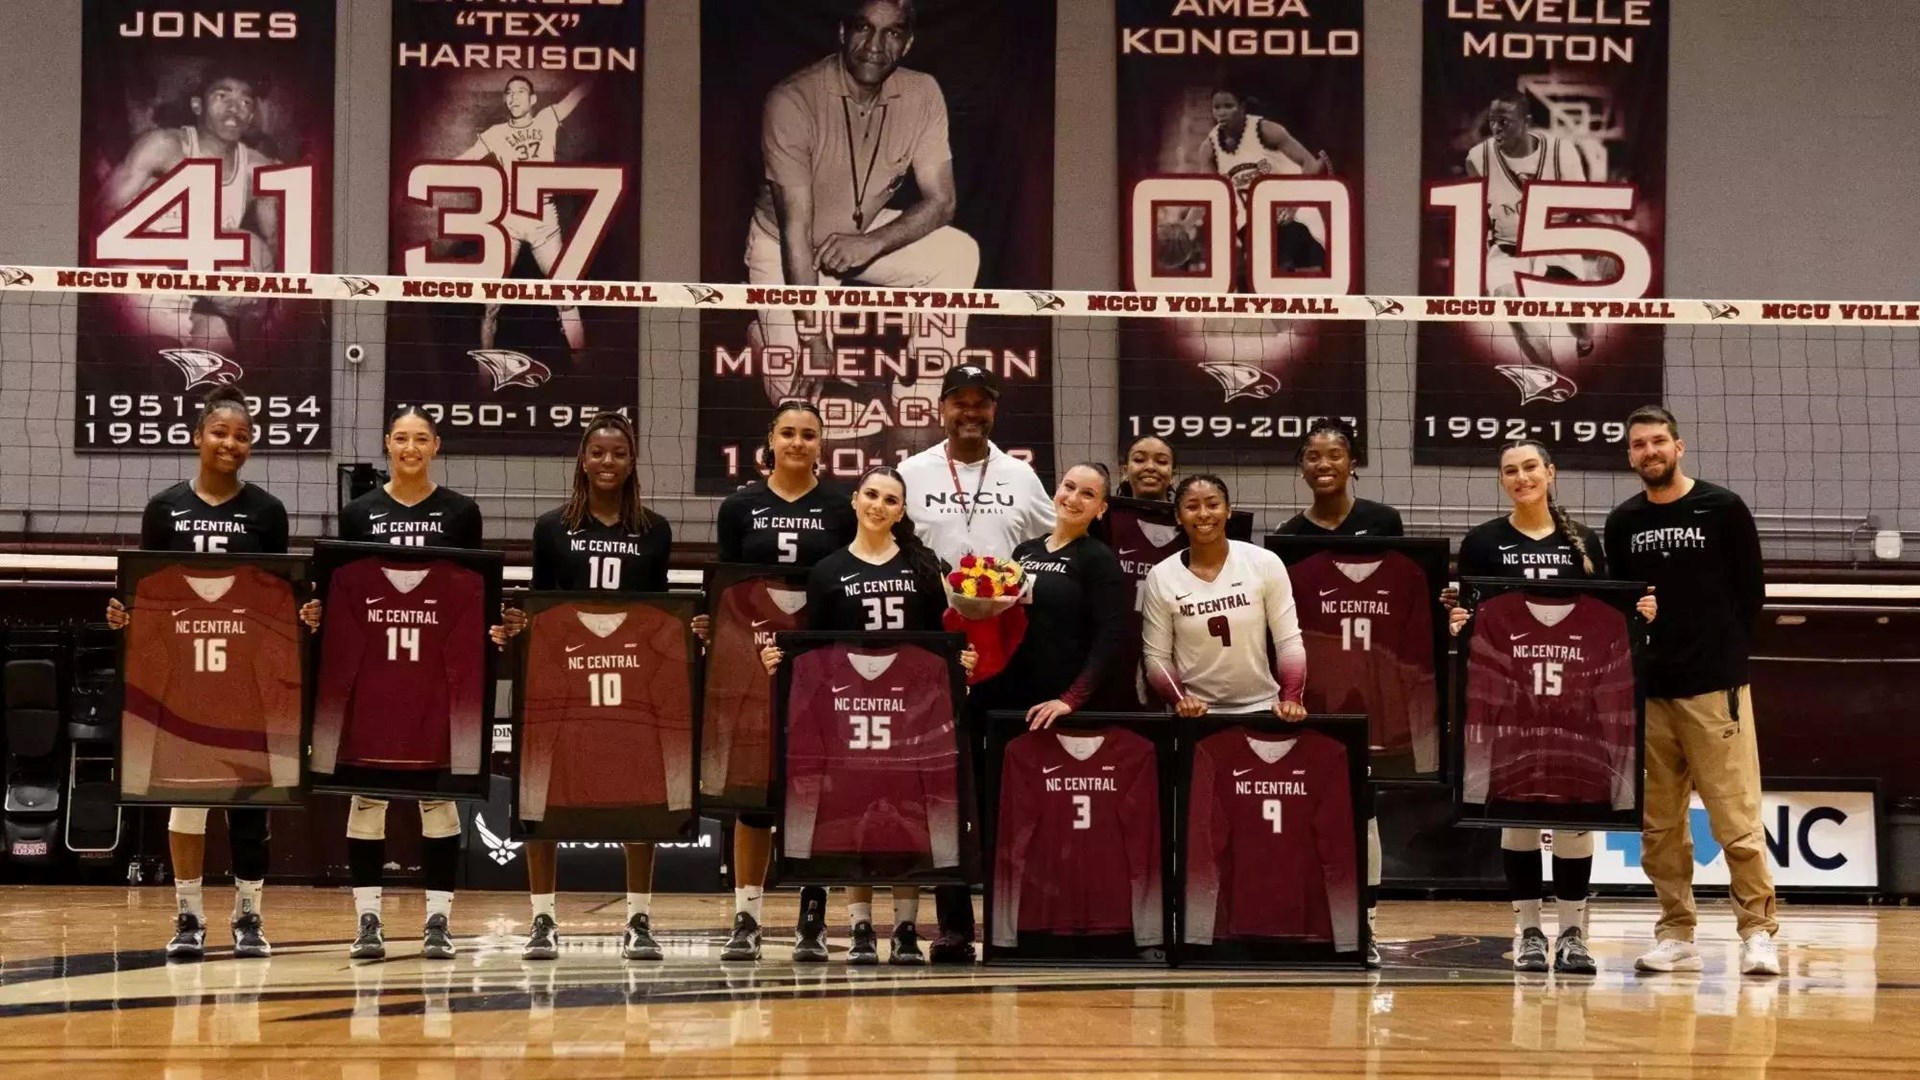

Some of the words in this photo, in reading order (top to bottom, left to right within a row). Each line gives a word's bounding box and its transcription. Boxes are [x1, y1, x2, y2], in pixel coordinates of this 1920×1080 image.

[1172, 0, 1310, 17] AMBA
[1448, 0, 1651, 25] LEVELLE
[119, 11, 296, 38] JONES
[1123, 28, 1359, 55] KONGOLO
[1463, 31, 1633, 63] MOTON
[399, 42, 636, 71] HARRISON
[96, 160, 314, 272] 41
[404, 162, 625, 280] 37
[1131, 176, 1352, 294] 00
[1429, 180, 1652, 298] 15
[57, 270, 129, 288] NCCU
[136, 272, 313, 295] VOLLEYBALL
[402, 281, 474, 299] NCCU
[481, 282, 658, 303] VOLLEYBALL
[746, 288, 818, 306] NCCU
[825, 289, 1000, 309] VOLLEYBALL
[1087, 295, 1159, 312] NCCU
[1165, 296, 1339, 315] VOLLEYBALL
[1426, 299, 1497, 316] NCCU
[1503, 300, 1676, 319] VOLLEYBALL
[1761, 303, 1831, 320] NCCU
[798, 310, 956, 338] JOHN
[715, 347, 1037, 379] MCLENDON
[86, 394, 321, 418] 1951-954
[397, 403, 632, 427] 950-195
[1129, 415, 1357, 438] 1999-20
[1425, 415, 1624, 443] 1992-199
[925, 491, 1015, 508] NCCU
[175, 520, 191, 532] NC
[193, 520, 247, 534] CENTRAL
[372, 522, 387, 535] NC
[389, 521, 443, 533] CENTRAL
[753, 517, 769, 530] NC
[771, 517, 825, 530] CENTRAL
[570, 539, 586, 551] NC
[588, 540, 641, 556] CENTRAL
[777, 531, 799, 563] 5
[1636, 527, 1706, 545] CENTRAL
[1023, 560, 1067, 573] CENTRAL
[1502, 553, 1519, 565] NC
[1521, 553, 1574, 566] CENTRAL
[588, 556, 622, 590] 10
[844, 582, 861, 597] NC
[863, 579, 917, 593] CENTRAL
[368, 609, 383, 622] NC
[386, 609, 439, 624] CENTRAL
[861, 596, 905, 631] 35
[1180, 604, 1196, 617] NC
[1197, 593, 1250, 615] CENTRAL
[1321, 601, 1337, 614] NC
[1340, 601, 1391, 615] CENTRAL
[175, 621, 190, 634] NC
[193, 620, 246, 634] CENTRAL
[1207, 615, 1231, 647] 9
[1340, 617, 1372, 651] 19
[193, 638, 227, 672] 16
[386, 626, 420, 662] 14
[1513, 645, 1529, 658] NC
[1531, 645, 1584, 660] CENTRAL
[568, 656, 584, 670] NC
[587, 654, 641, 669] CENTRAL
[588, 673, 622, 707] 10
[1532, 662, 1563, 696] 15
[834, 698, 850, 711] NC
[853, 698, 906, 712] CENTRAL
[849, 715, 891, 750] 35
[1046, 778, 1062, 792] NC
[1064, 777, 1118, 791] CENTRAL
[1236, 781, 1252, 795] NC
[1255, 781, 1308, 795] CENTRAL
[1072, 795, 1091, 830] 3
[1262, 799, 1283, 834] 9
